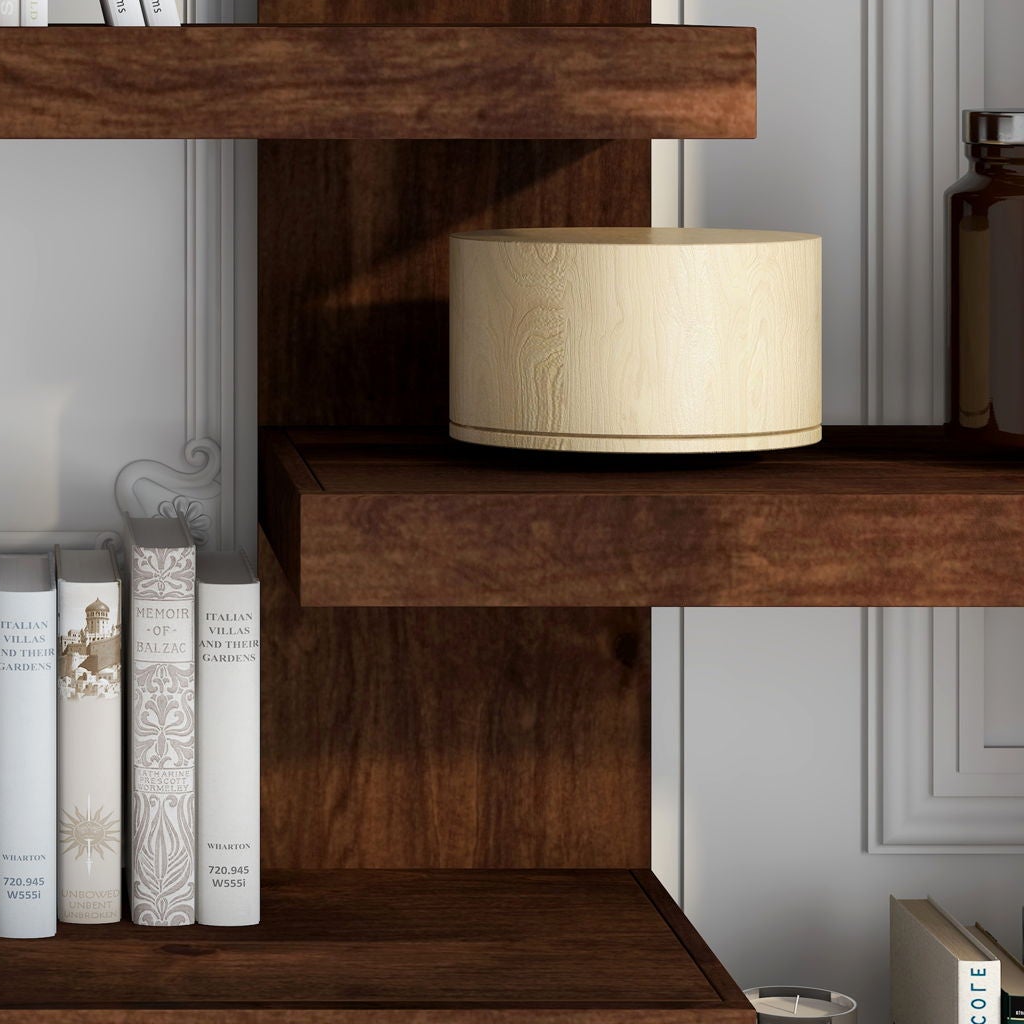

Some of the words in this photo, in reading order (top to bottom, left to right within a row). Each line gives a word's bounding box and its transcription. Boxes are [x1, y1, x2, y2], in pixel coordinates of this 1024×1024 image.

[136, 608, 189, 619] MEMOIR
[206, 612, 253, 622] ITALIAN
[0, 620, 48, 630] ITALIAN
[208, 626, 250, 636] VILLAS
[4, 634, 46, 644] VILLAS
[136, 641, 186, 654] BALZAC
[199, 640, 224, 650] AND
[226, 640, 260, 650] THEIR
[20, 648, 55, 658] THEIR
[202, 653, 256, 664] GARDENS
[207, 842, 251, 851] WHARTON
[2, 854, 46, 862] WHARTON
[208, 865, 250, 876] 720.945
[3, 876, 44, 887] 720.945
[212, 878, 246, 888] W555i
[6, 889, 40, 900] W555i
